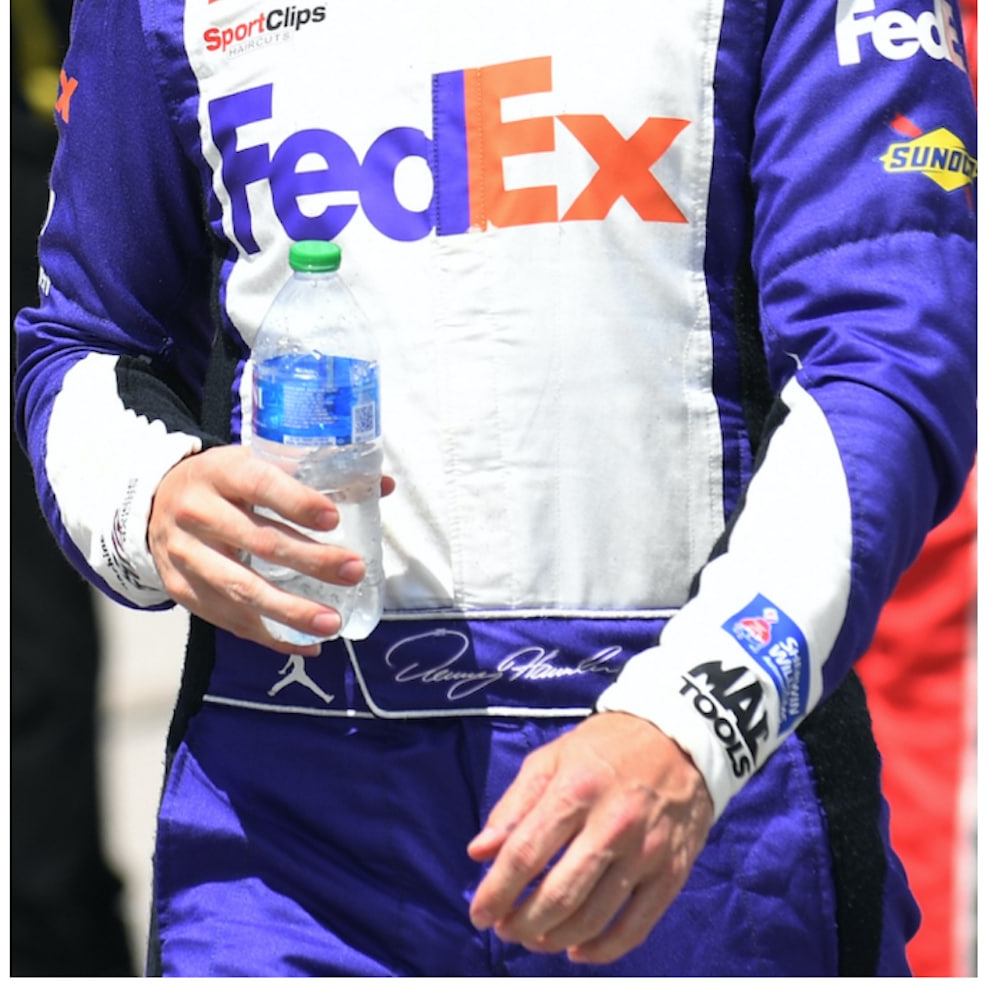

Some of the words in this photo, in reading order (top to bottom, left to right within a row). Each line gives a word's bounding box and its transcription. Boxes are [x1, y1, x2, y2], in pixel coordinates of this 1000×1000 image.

[229, 31, 290, 56] HAIRCUTS
[208, 55, 691, 256] FedEx
[890, 146, 977, 178] SUNOC
[679, 675, 752, 778] TOOLS
